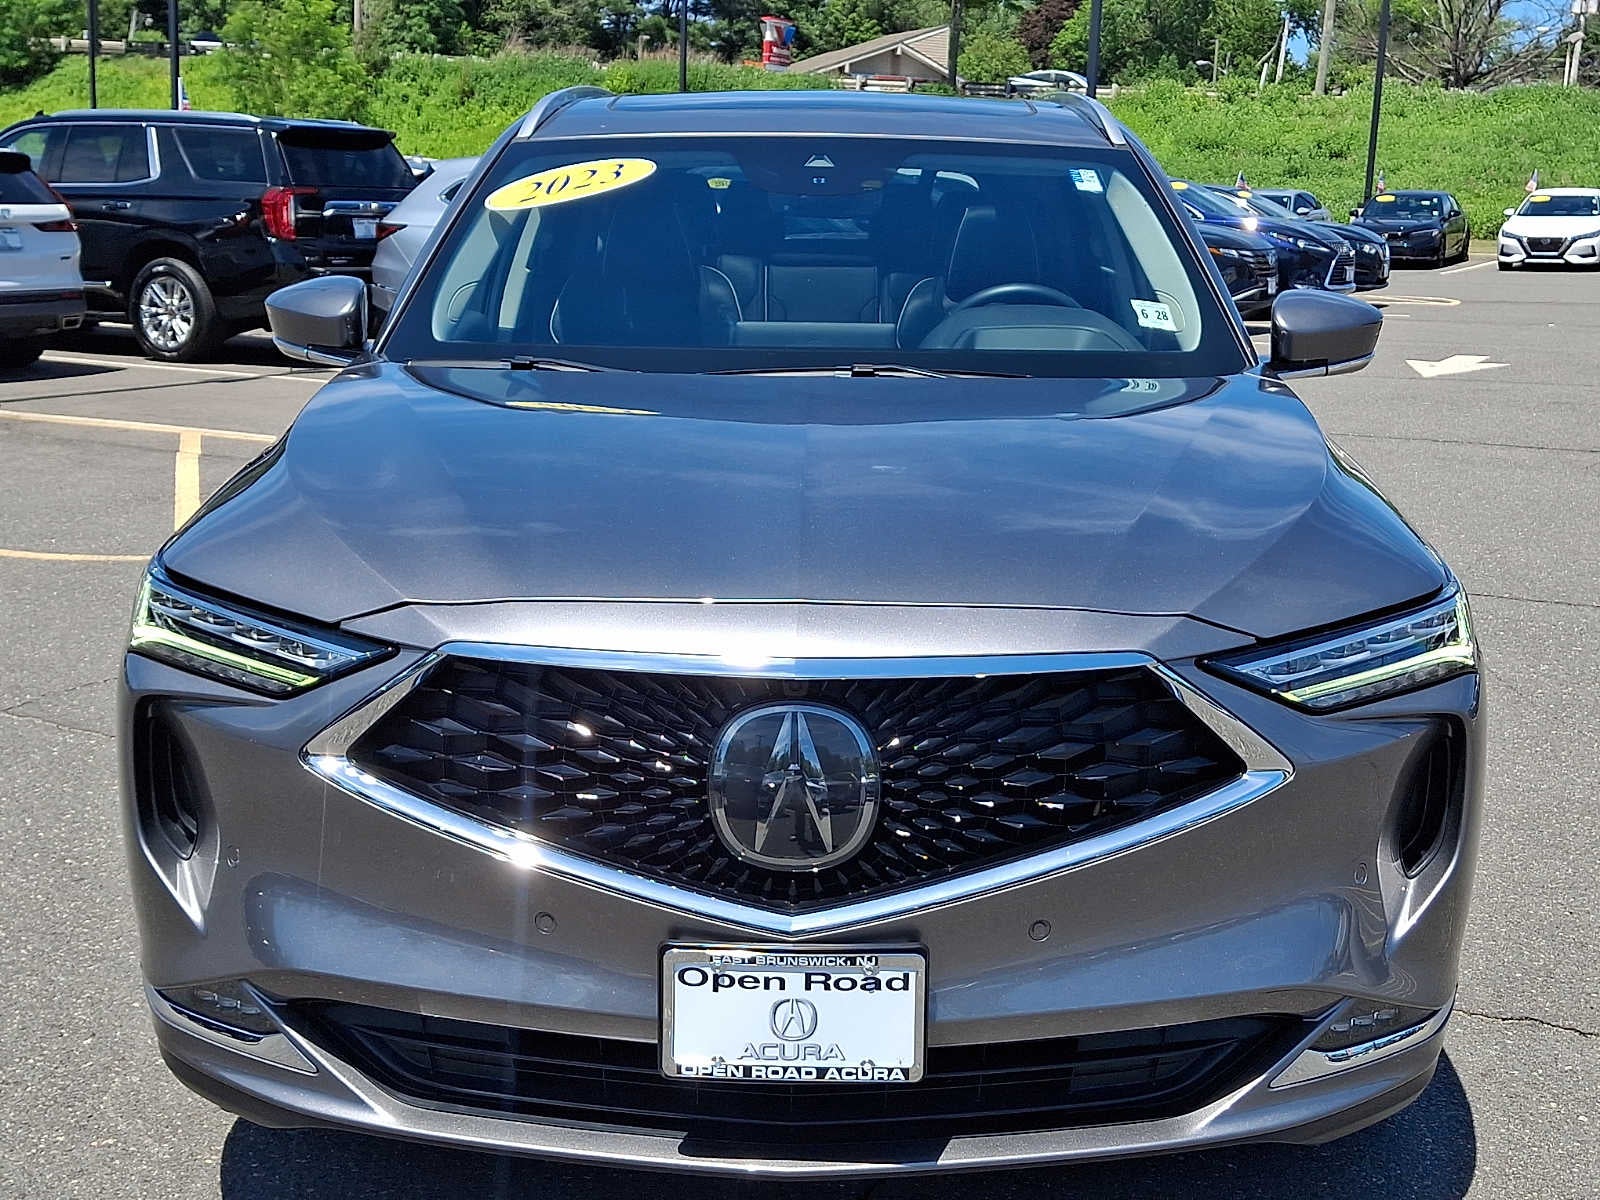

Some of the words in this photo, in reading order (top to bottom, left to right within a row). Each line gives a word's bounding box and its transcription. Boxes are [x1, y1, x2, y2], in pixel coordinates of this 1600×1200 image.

[517, 163, 625, 203] 2023
[1141, 308, 1149, 319] 6
[1155, 310, 1169, 321] 28
[711, 955, 750, 966] EAST
[856, 956, 876, 967] NJ
[677, 966, 786, 993] Open
[804, 971, 910, 992] Road
[736, 1042, 846, 1062] ACURA
[680, 1064, 744, 1078] OPEN
[751, 1065, 818, 1079] ROAD
[824, 1066, 906, 1081] ACURA
